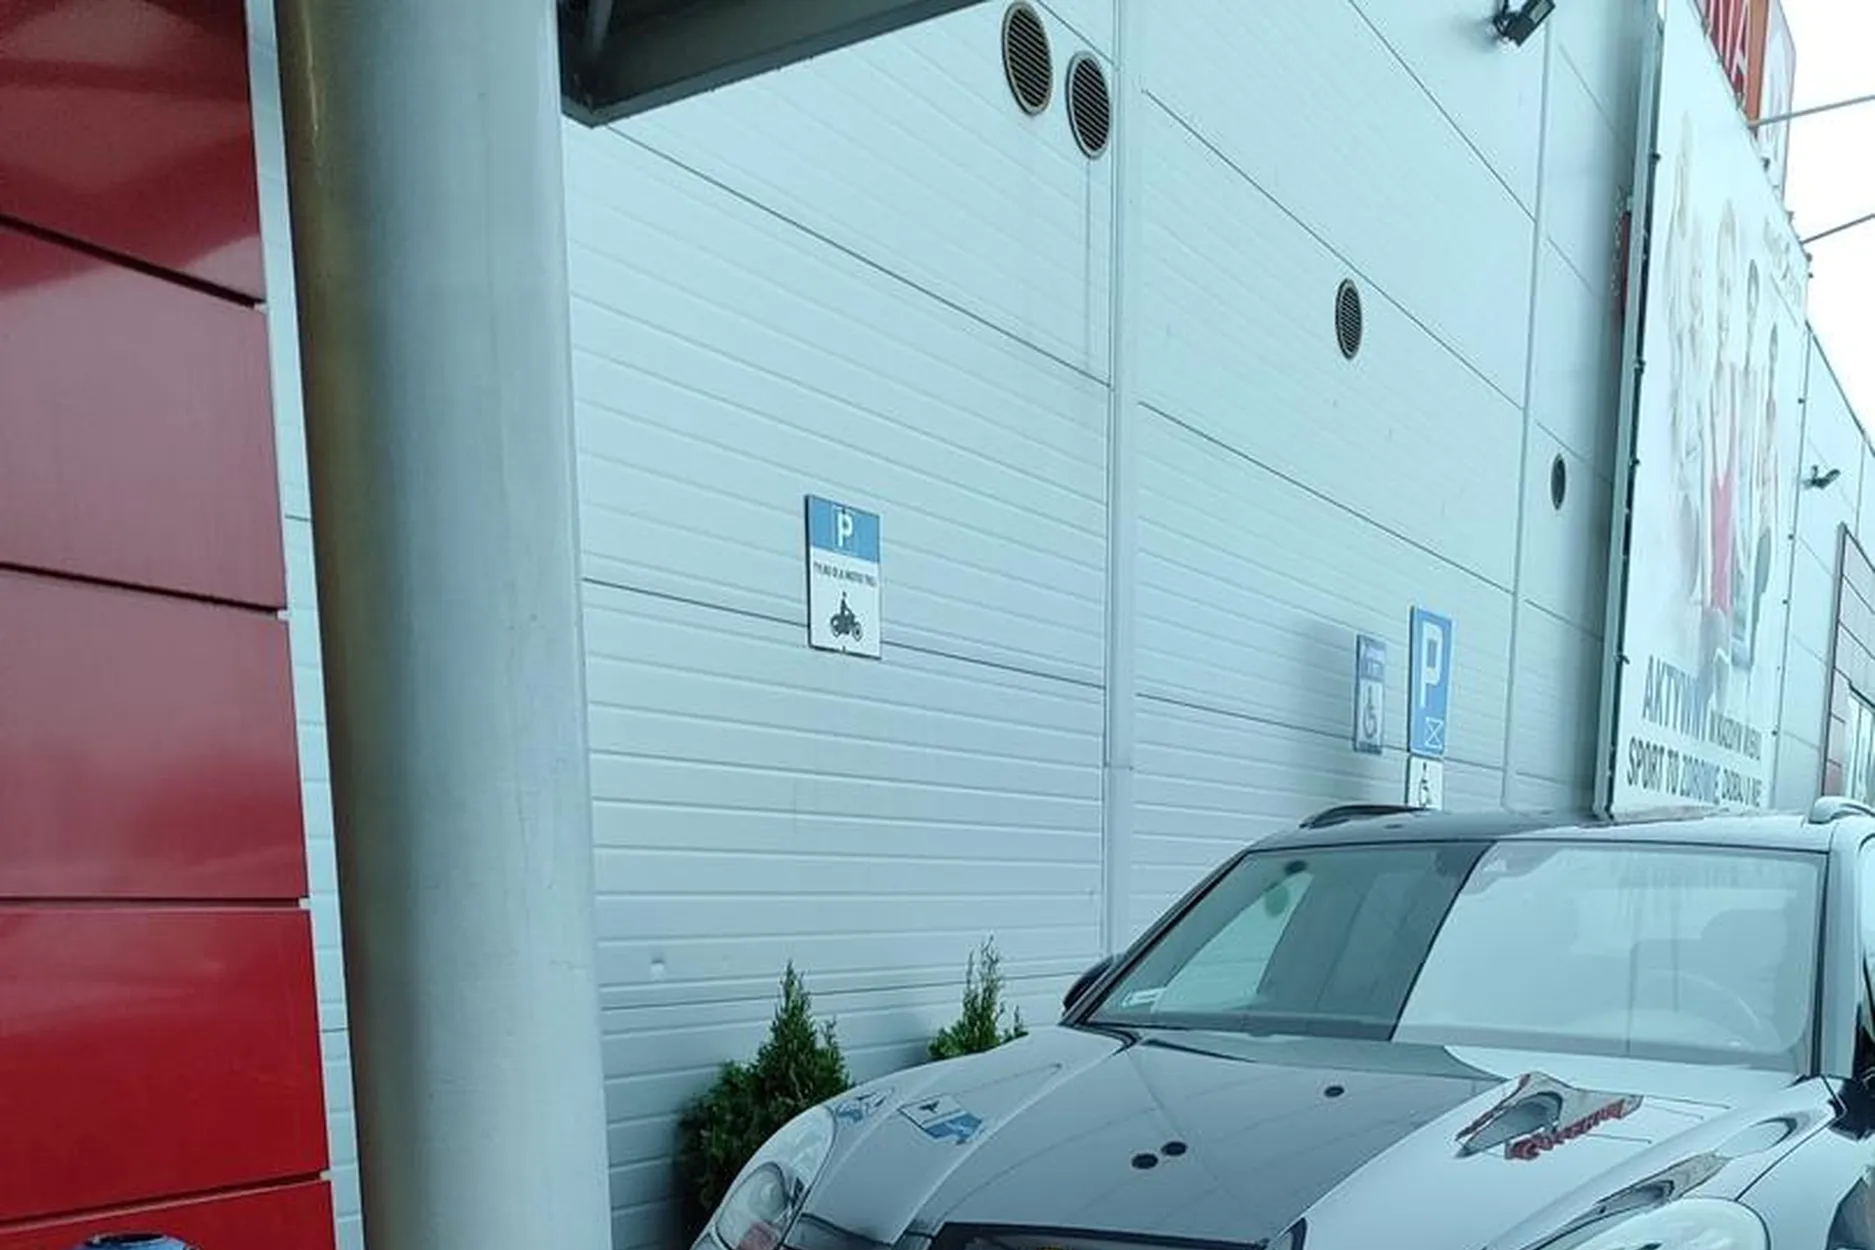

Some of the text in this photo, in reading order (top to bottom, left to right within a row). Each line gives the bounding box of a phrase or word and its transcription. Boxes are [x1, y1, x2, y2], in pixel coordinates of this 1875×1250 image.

[836, 510, 854, 548] P
[1419, 619, 1444, 710] P
[1627, 735, 1665, 793] SPORT
[1667, 747, 1679, 796] TO
